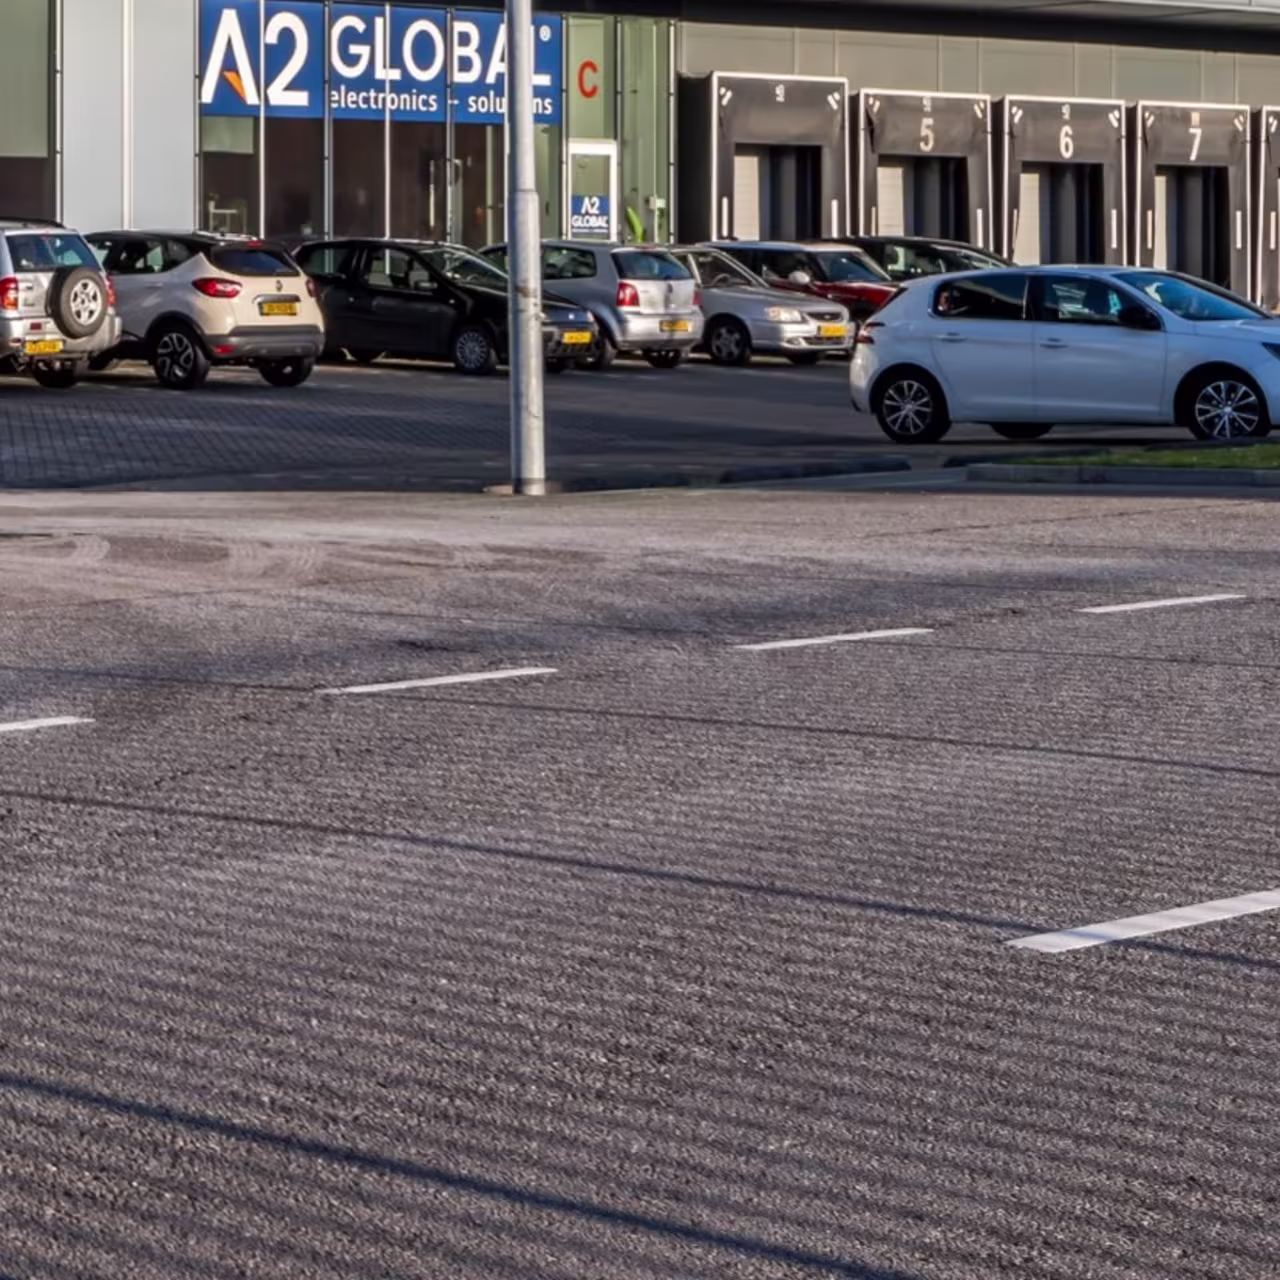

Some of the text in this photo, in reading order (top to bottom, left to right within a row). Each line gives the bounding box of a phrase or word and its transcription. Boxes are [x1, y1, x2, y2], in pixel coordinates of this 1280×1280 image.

[200, 8, 309, 107] A2
[577, 59, 599, 99] C
[330, 84, 438, 112] electronics
[468, 89, 553, 115] soluns
[919, 117, 935, 152] 5
[1059, 124, 1074, 159] 6
[1188, 127, 1203, 161] 7
